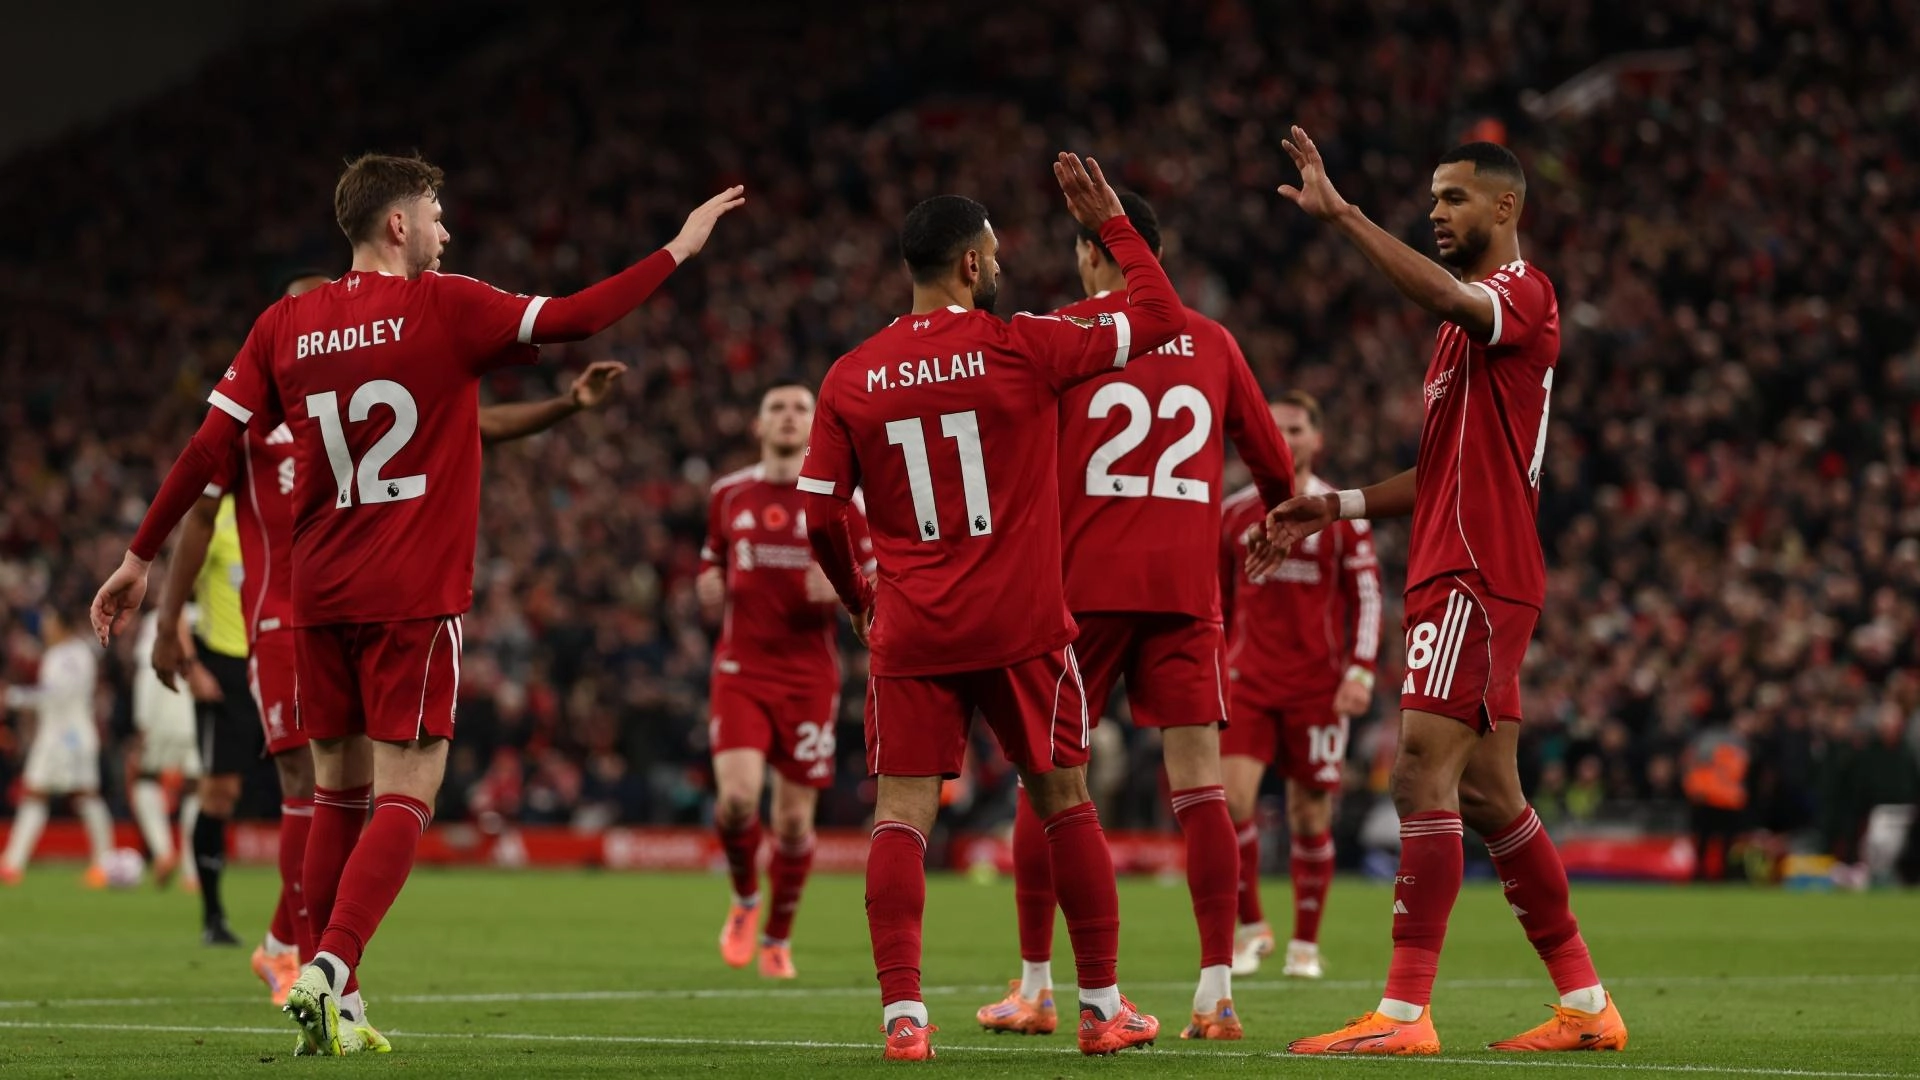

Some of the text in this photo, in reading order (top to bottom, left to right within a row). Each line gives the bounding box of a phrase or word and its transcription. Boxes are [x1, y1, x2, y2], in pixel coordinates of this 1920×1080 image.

[296, 318, 405, 360] BRADLEY
[306, 380, 427, 510] 12
[1086, 382, 1212, 504] 22
[885, 410, 992, 542] 11
[1406, 622, 1438, 669] 8
[795, 722, 836, 761] 26
[1308, 725, 1343, 764] 10
